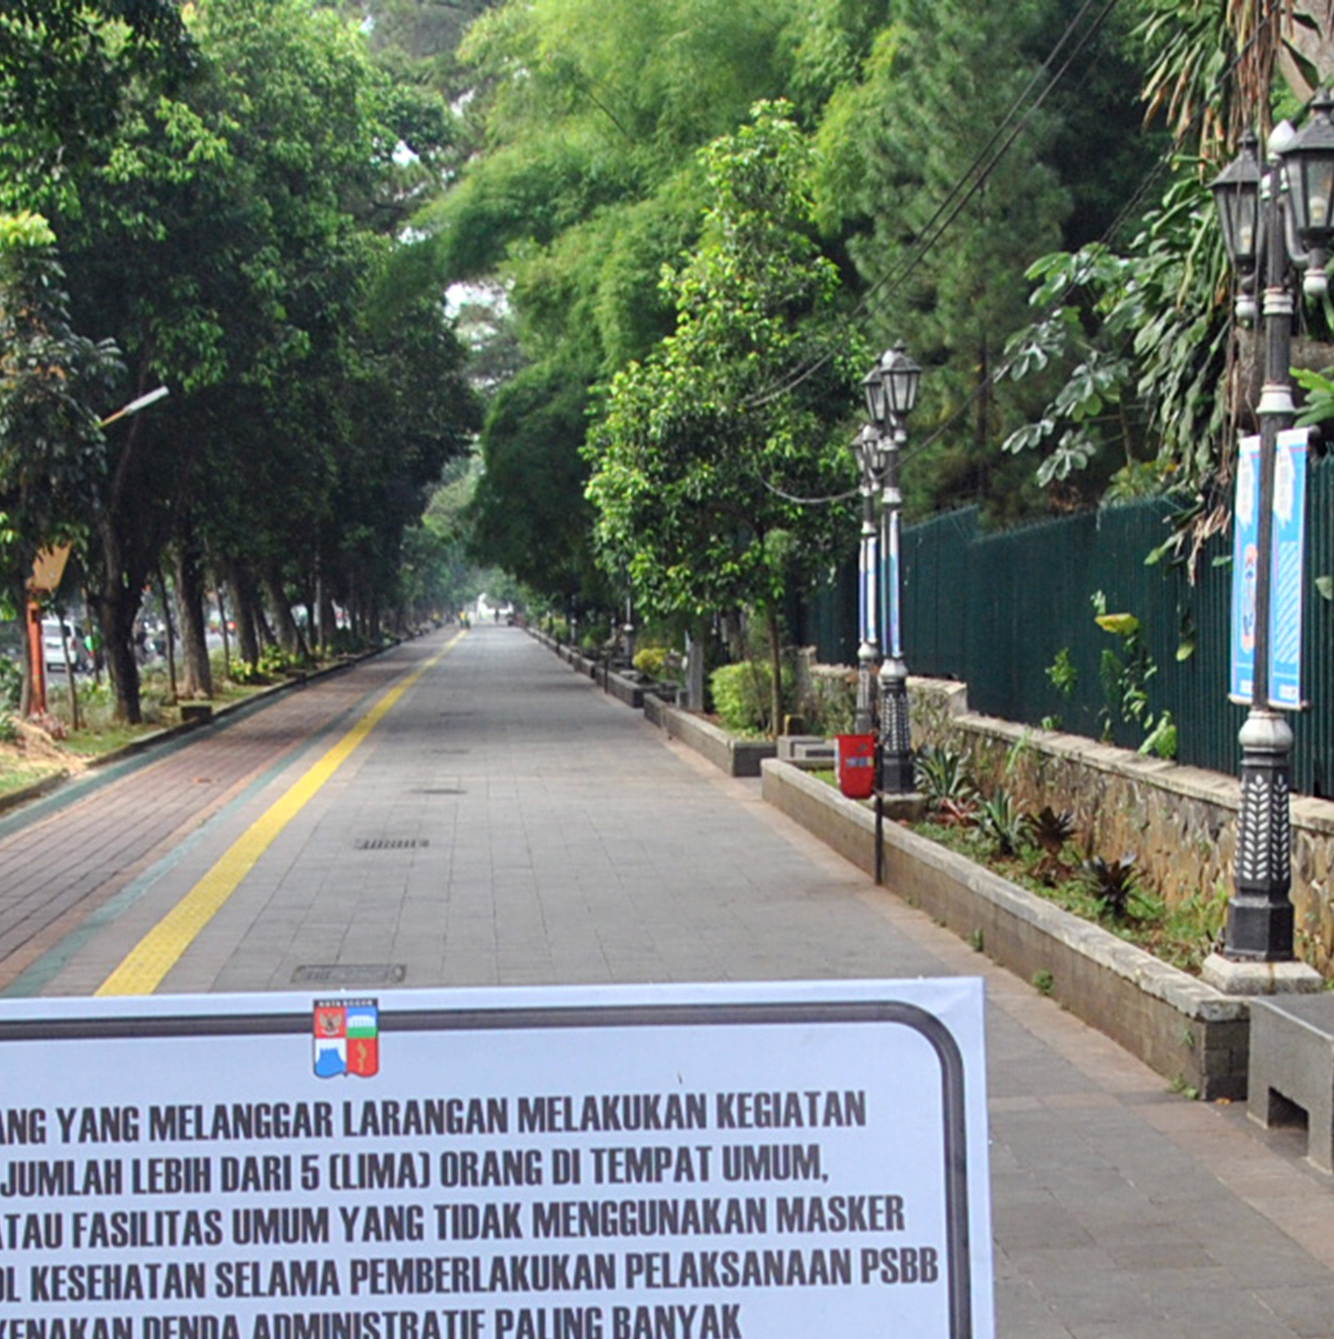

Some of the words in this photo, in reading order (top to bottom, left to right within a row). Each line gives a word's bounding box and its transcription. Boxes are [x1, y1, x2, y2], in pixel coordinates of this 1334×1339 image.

[56, 1106, 139, 1143] YANG
[149, 1102, 333, 1142] MELANGGAR
[343, 1097, 508, 1137] LARANGAN
[518, 1093, 707, 1133] MELAKUKAN
[716, 1090, 866, 1129] KEGIATAN
[0, 1159, 122, 1197] JUMLAH
[132, 1157, 211, 1194] LEBIH
[221, 1155, 291, 1192] DARI
[301, 1154, 320, 1191] 5
[329, 1152, 430, 1190] (LIMA)
[440, 1149, 542, 1187] ORANG
[552, 1148, 581, 1185] DI
[590, 1146, 712, 1184] TEMPAT
[722, 1144, 828, 1183] UMUM,
[73, 1209, 223, 1248] FASILITAS
[233, 1207, 329, 1245] UMUM
[339, 1205, 424, 1242] YANG
[433, 1202, 523, 1240] TIDAK
[532, 1197, 767, 1238] MENGGUNAKAN
[776, 1195, 905, 1233] MASKER
[31, 1262, 205, 1302] KESEHATAN
[215, 1260, 340, 1298] SELAMA
[350, 1253, 616, 1295] PEMBERLAKUKAN
[625, 1248, 851, 1289] PELAKSANAAN
[861, 1247, 938, 1284] PSBB
